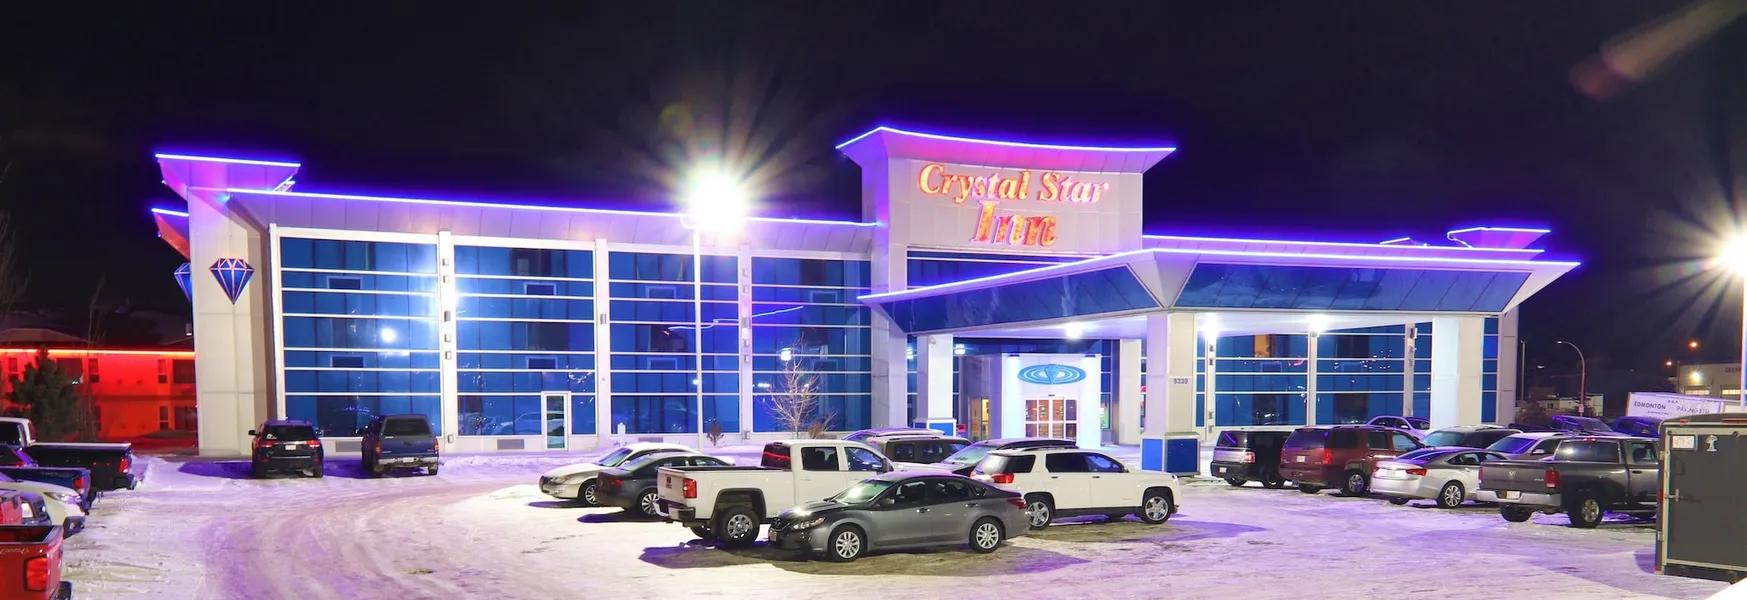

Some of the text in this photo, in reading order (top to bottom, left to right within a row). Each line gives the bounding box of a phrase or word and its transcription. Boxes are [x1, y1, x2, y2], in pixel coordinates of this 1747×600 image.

[918, 163, 1110, 204] Crystal Star
[969, 199, 1058, 247] Inn
[1633, 401, 1667, 410] EDMONTON
